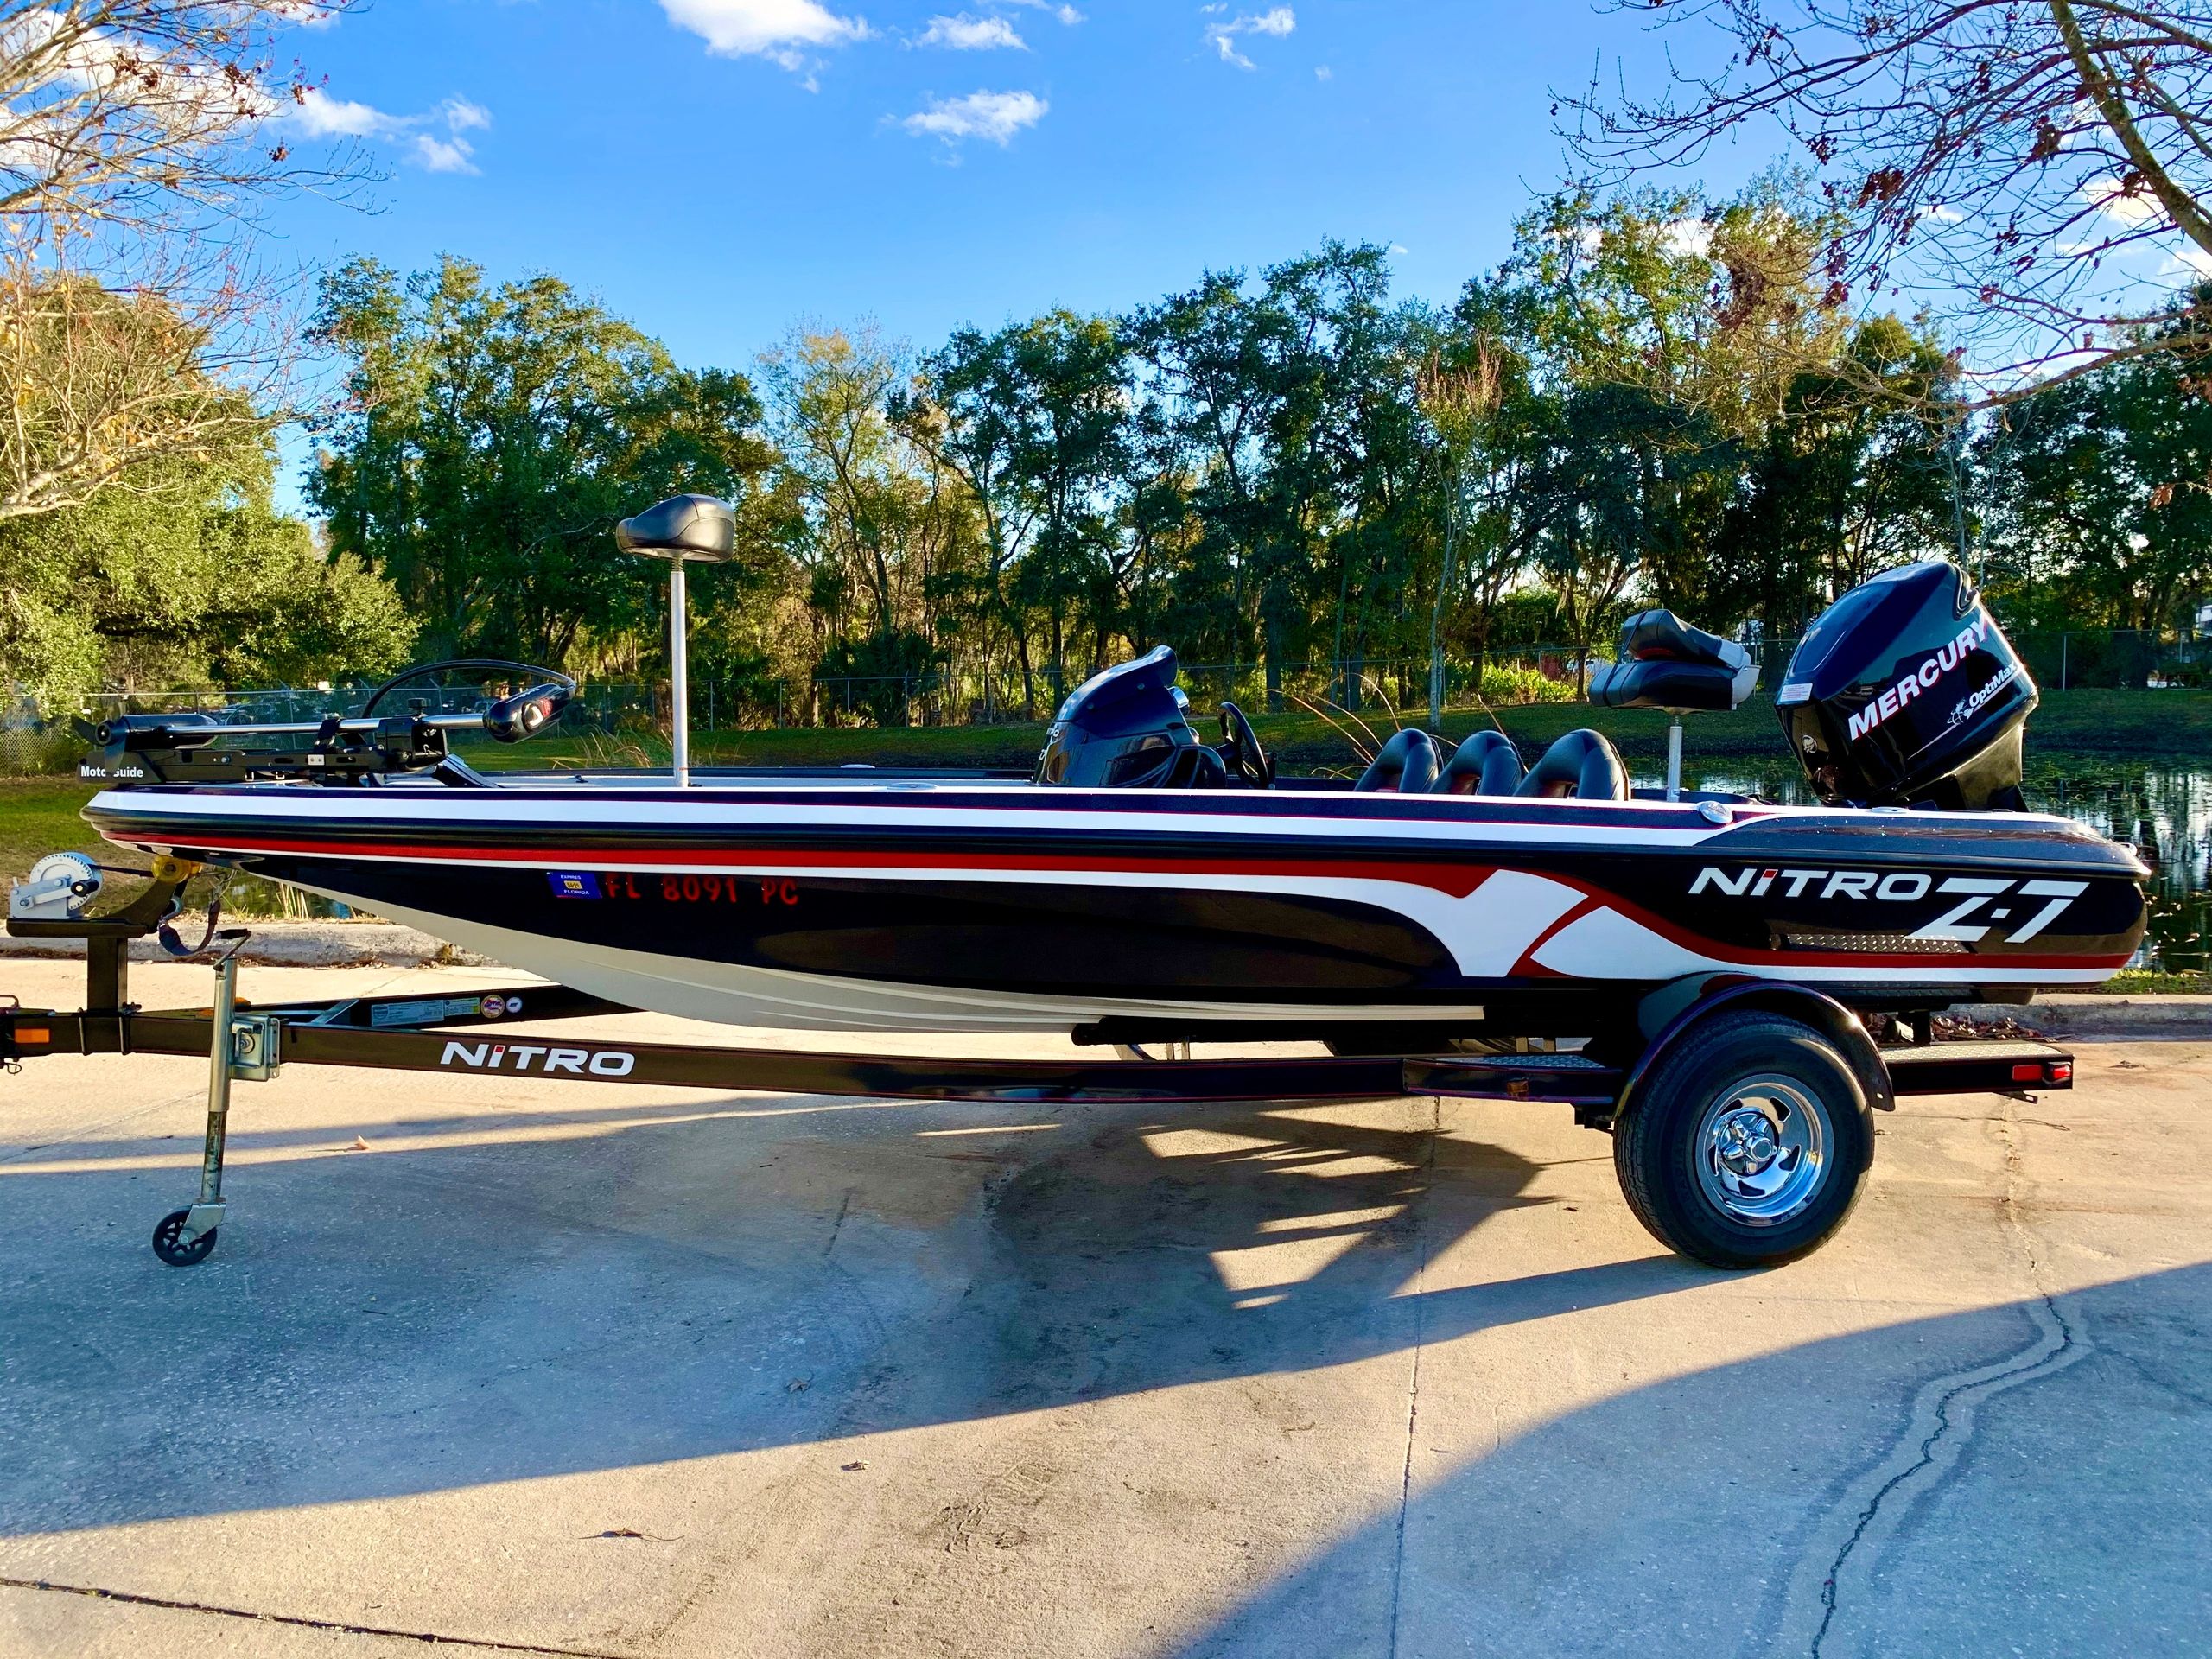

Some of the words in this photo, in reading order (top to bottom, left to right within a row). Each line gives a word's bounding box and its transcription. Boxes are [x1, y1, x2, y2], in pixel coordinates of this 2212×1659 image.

[1847, 613, 1987, 741] MERCURY
[1968, 661, 2018, 708] OptiMax
[605, 872, 641, 899] FL
[662, 874, 737, 903] 8091
[761, 876, 799, 906] PC
